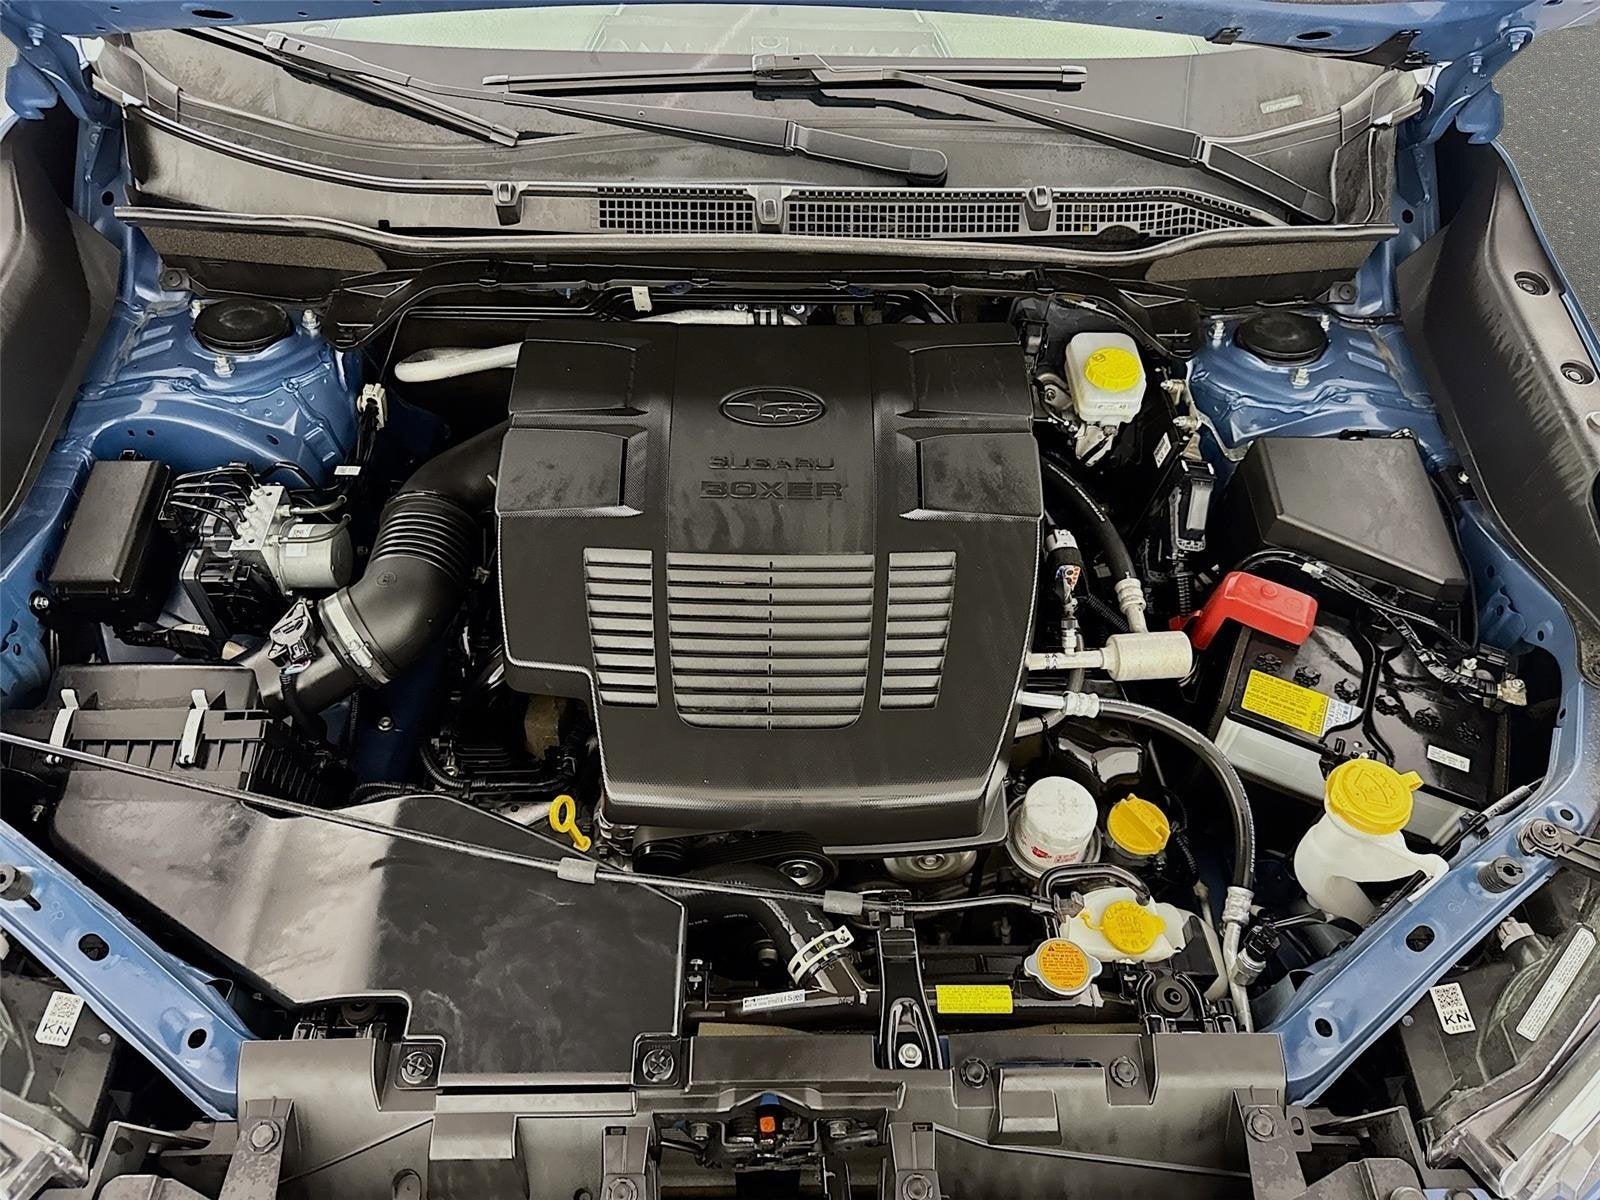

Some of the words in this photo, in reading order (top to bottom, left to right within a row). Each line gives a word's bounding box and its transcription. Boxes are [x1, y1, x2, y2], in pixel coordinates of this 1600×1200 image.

[707, 455, 835, 471] SUBARU
[701, 480, 843, 500] BOXER
[1443, 1012, 1469, 1025] KN
[42, 1023, 70, 1035] KN
